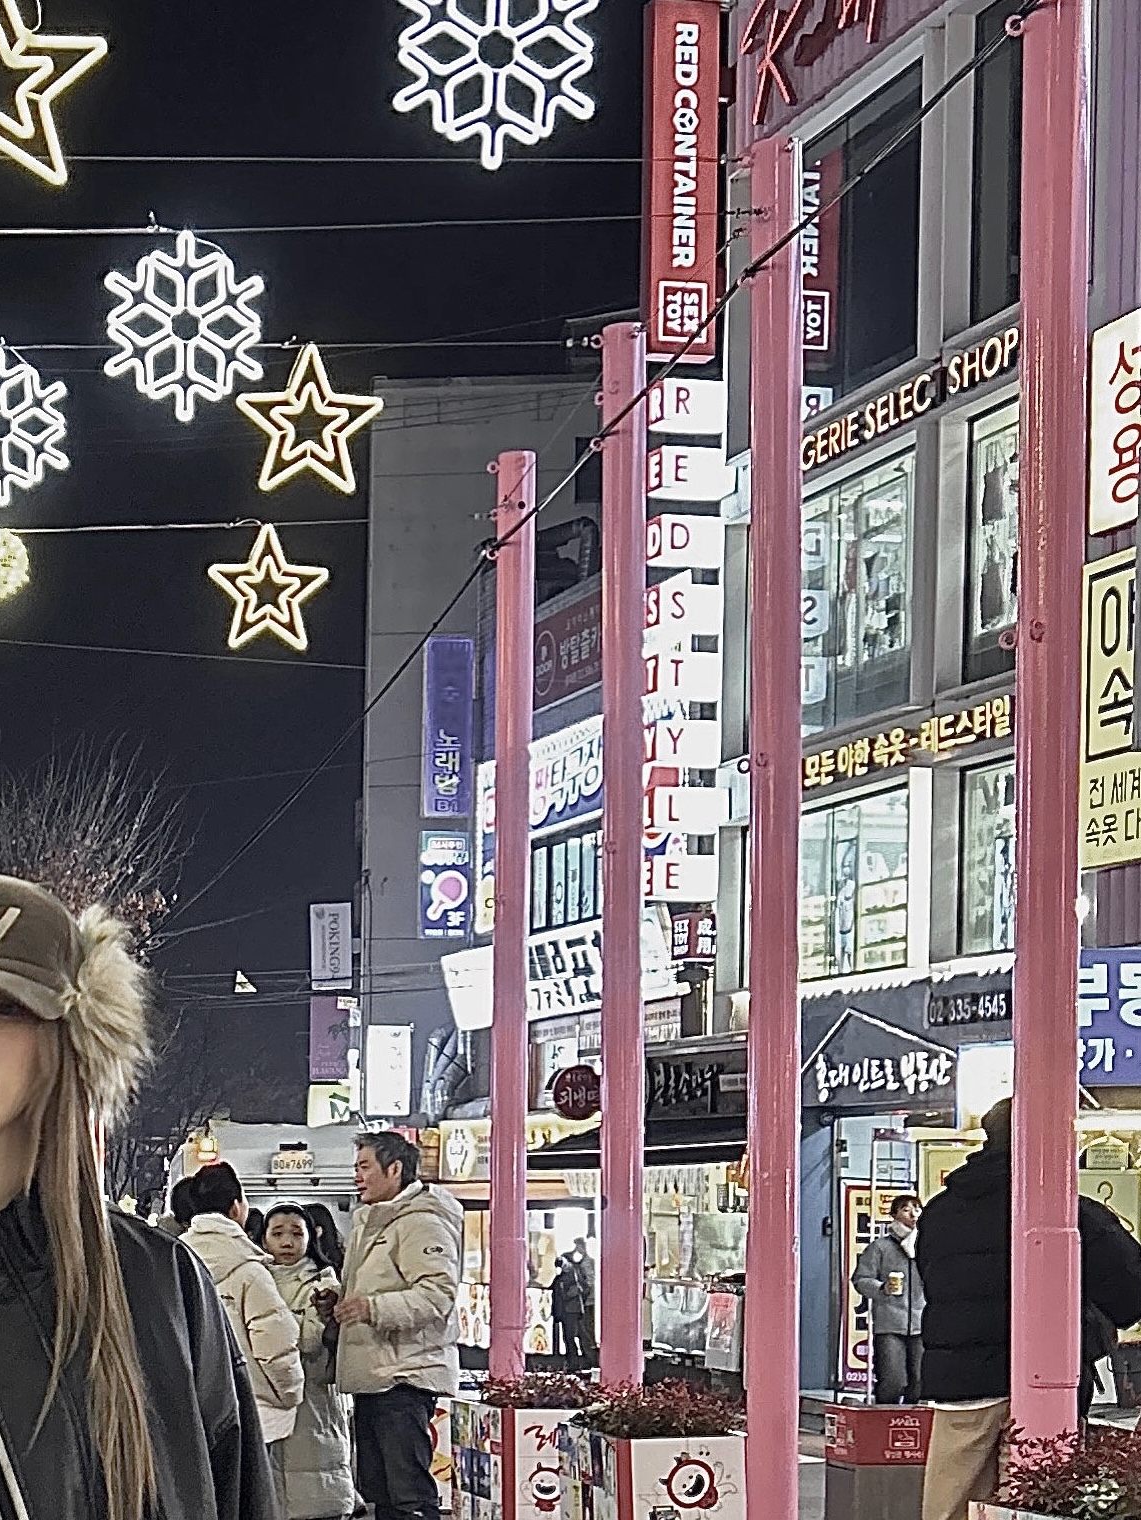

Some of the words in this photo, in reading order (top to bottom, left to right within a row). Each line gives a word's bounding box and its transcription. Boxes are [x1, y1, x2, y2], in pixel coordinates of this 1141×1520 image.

[667, 291, 681, 332] TOY
[683, 292, 699, 332] SEX
[863, 367, 947, 440] SELEC
[948, 327, 1019, 394] SHOP
[804, 749, 835, 787] 모든
[1089, 776, 1104, 809] 전
[1085, 813, 1118, 847] 속옷
[816, 1053, 849, 1103] 홍대
[852, 1057, 900, 1093] 인트로
[900, 1051, 953, 1095] 부동산
